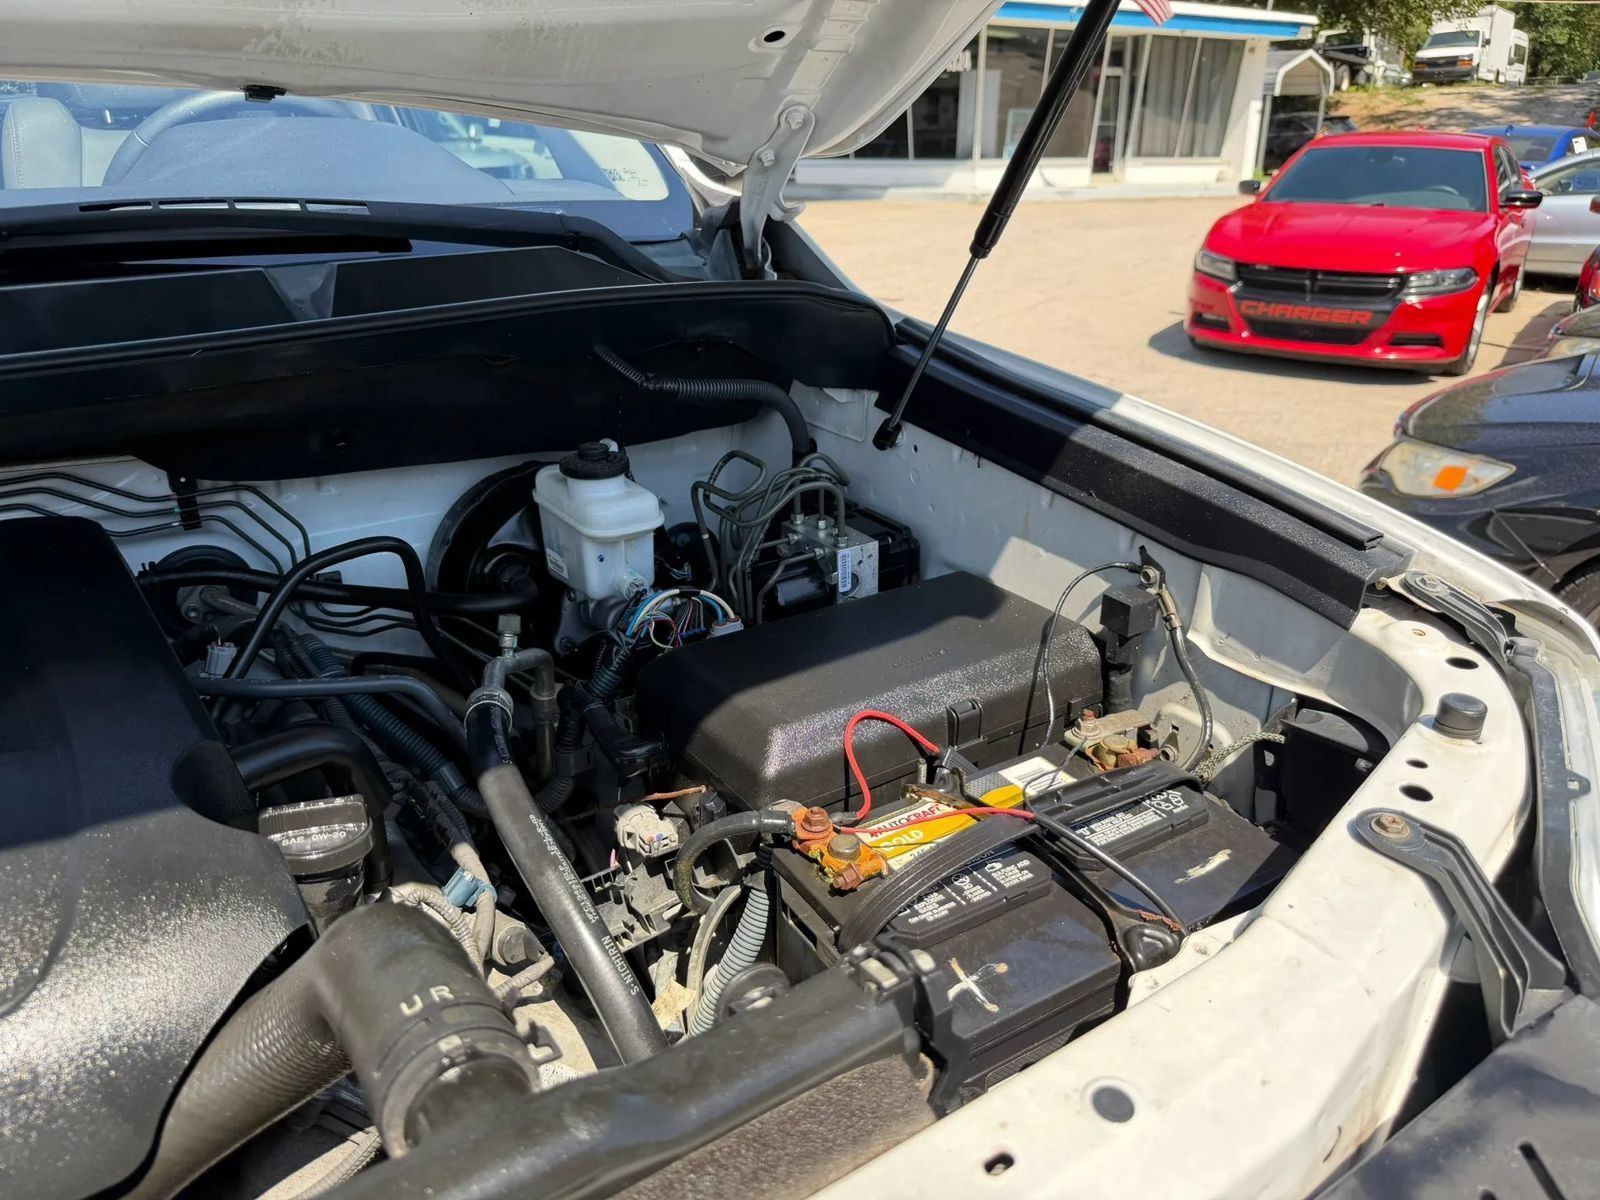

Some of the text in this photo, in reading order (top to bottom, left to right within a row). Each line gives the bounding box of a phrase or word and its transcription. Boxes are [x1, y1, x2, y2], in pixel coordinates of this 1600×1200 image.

[1240, 299, 1374, 325] CHARGER
[281, 831, 347, 846] SAE 0W-20
